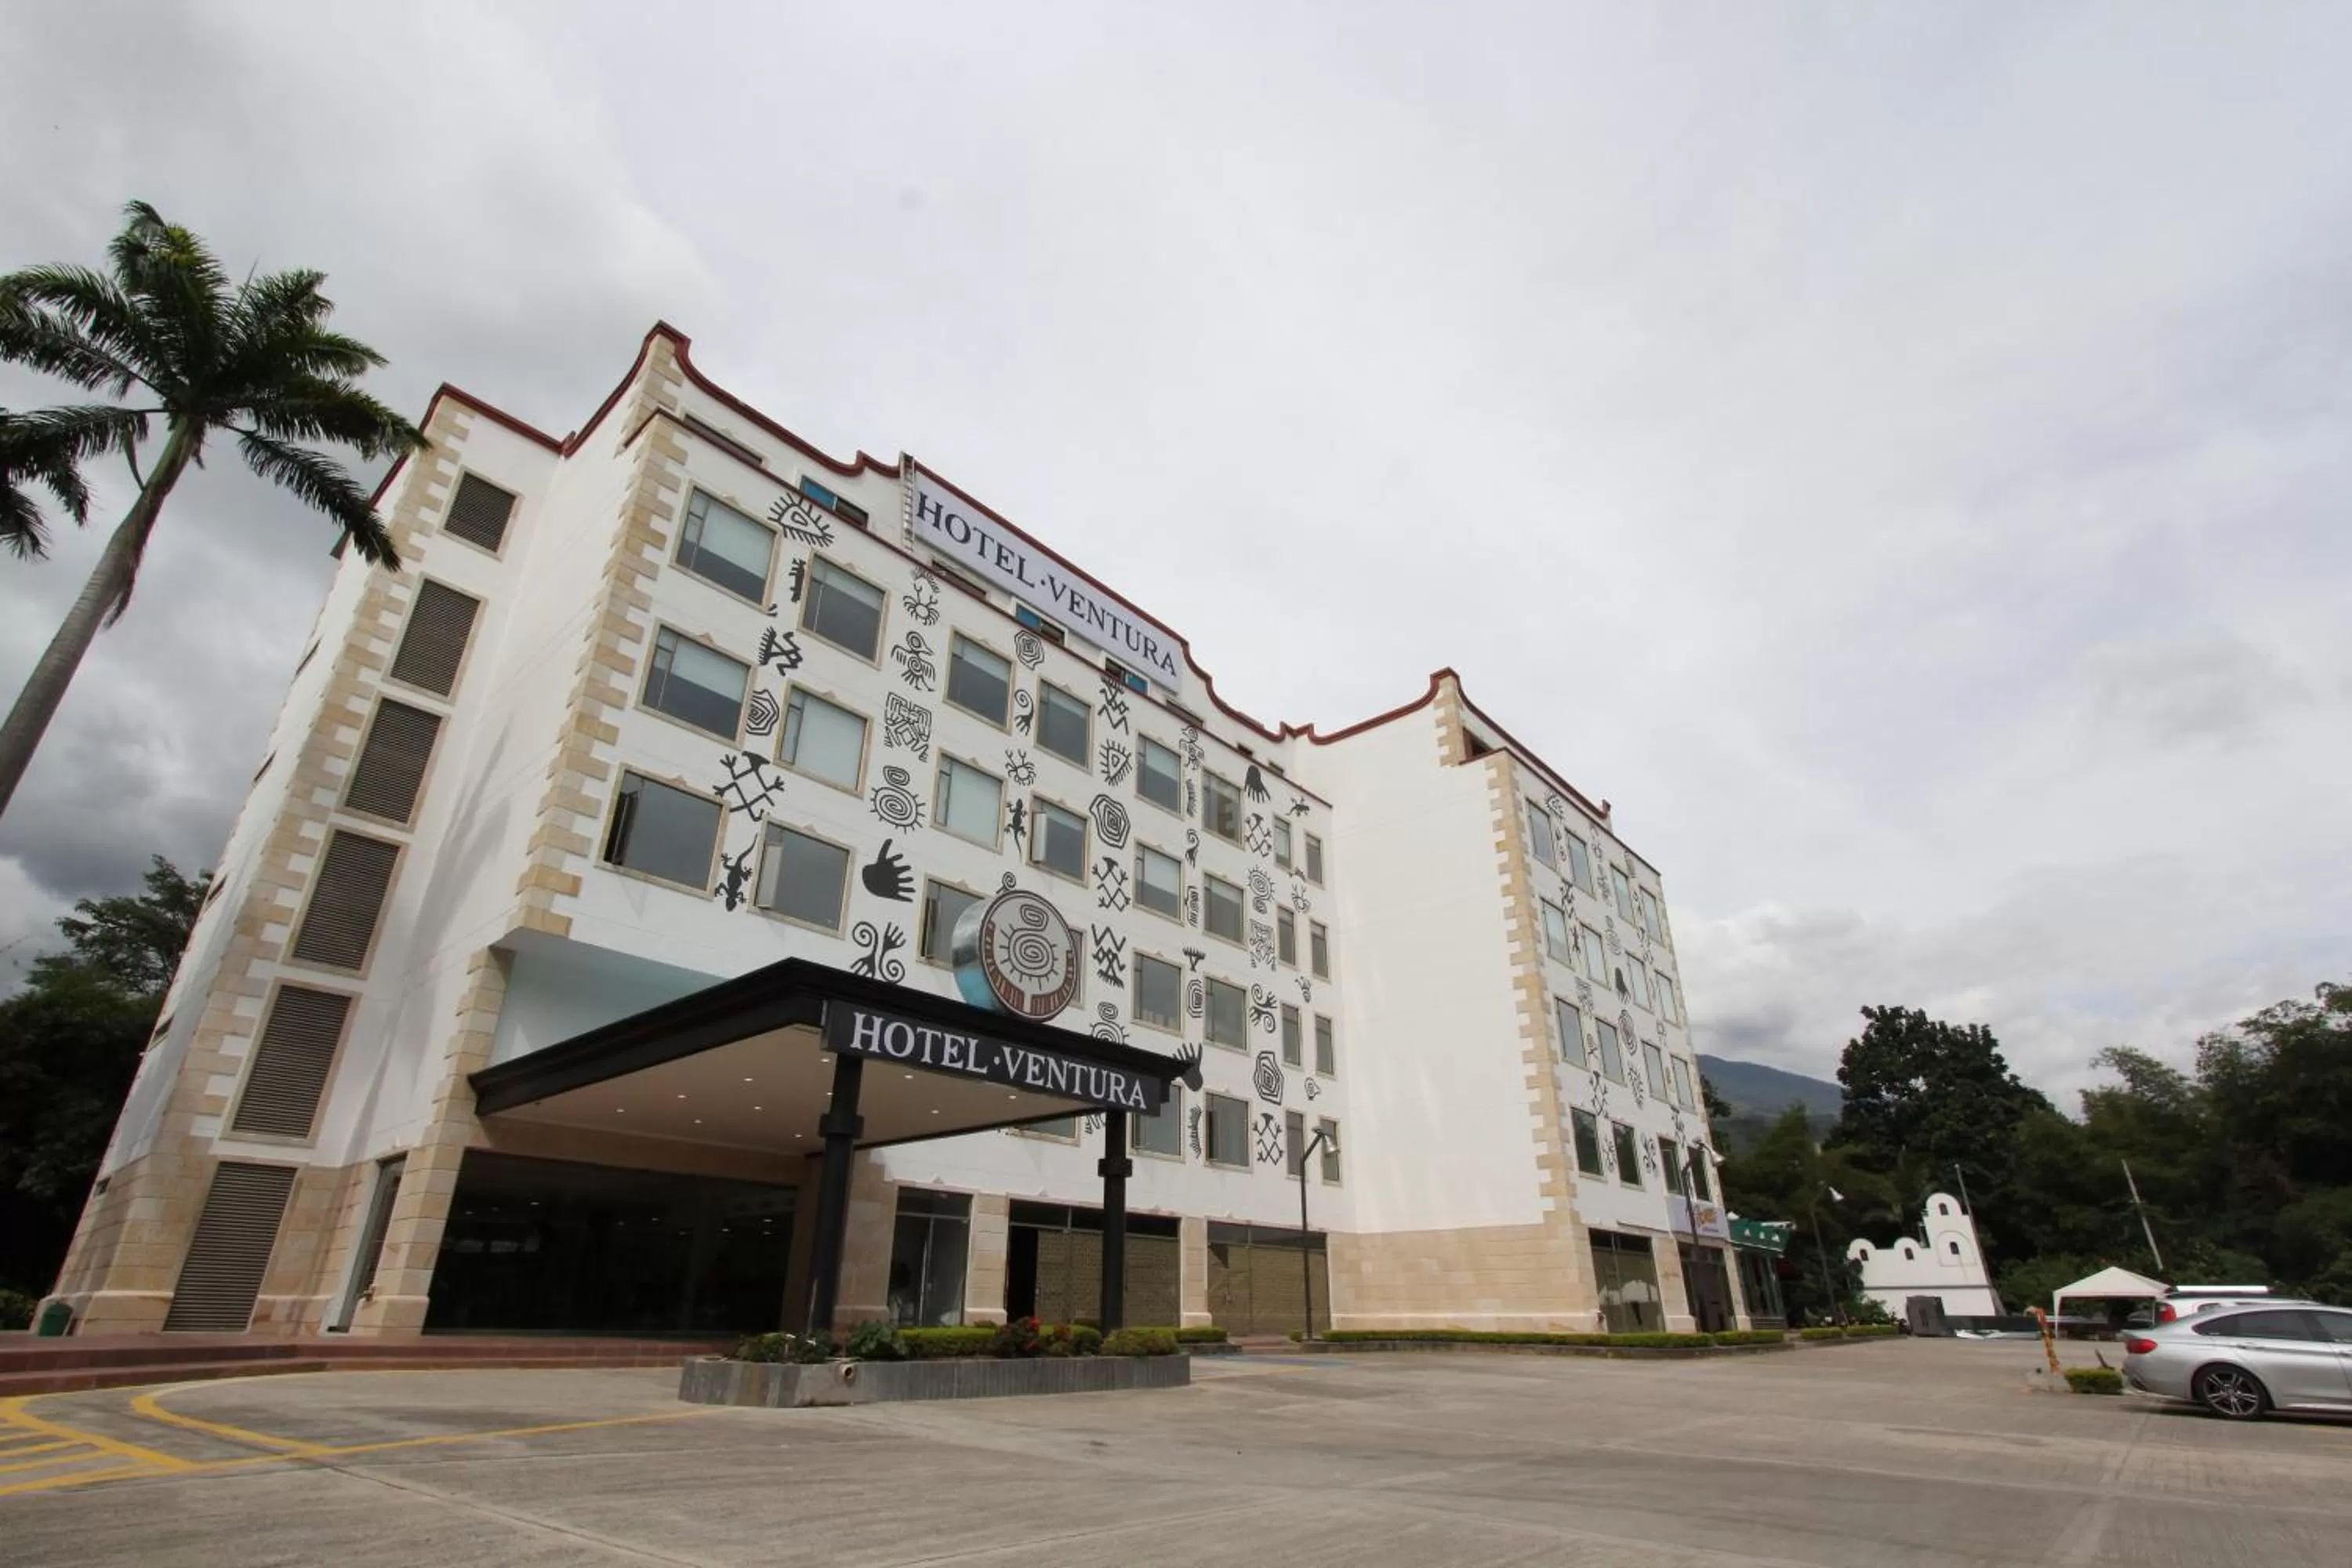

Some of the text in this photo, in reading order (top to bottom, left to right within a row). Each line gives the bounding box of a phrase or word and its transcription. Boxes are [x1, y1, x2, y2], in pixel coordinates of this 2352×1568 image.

[916, 491, 1177, 677] HOTEL VENTURA
[850, 1011, 1148, 1110] HOTEL VENTURA
